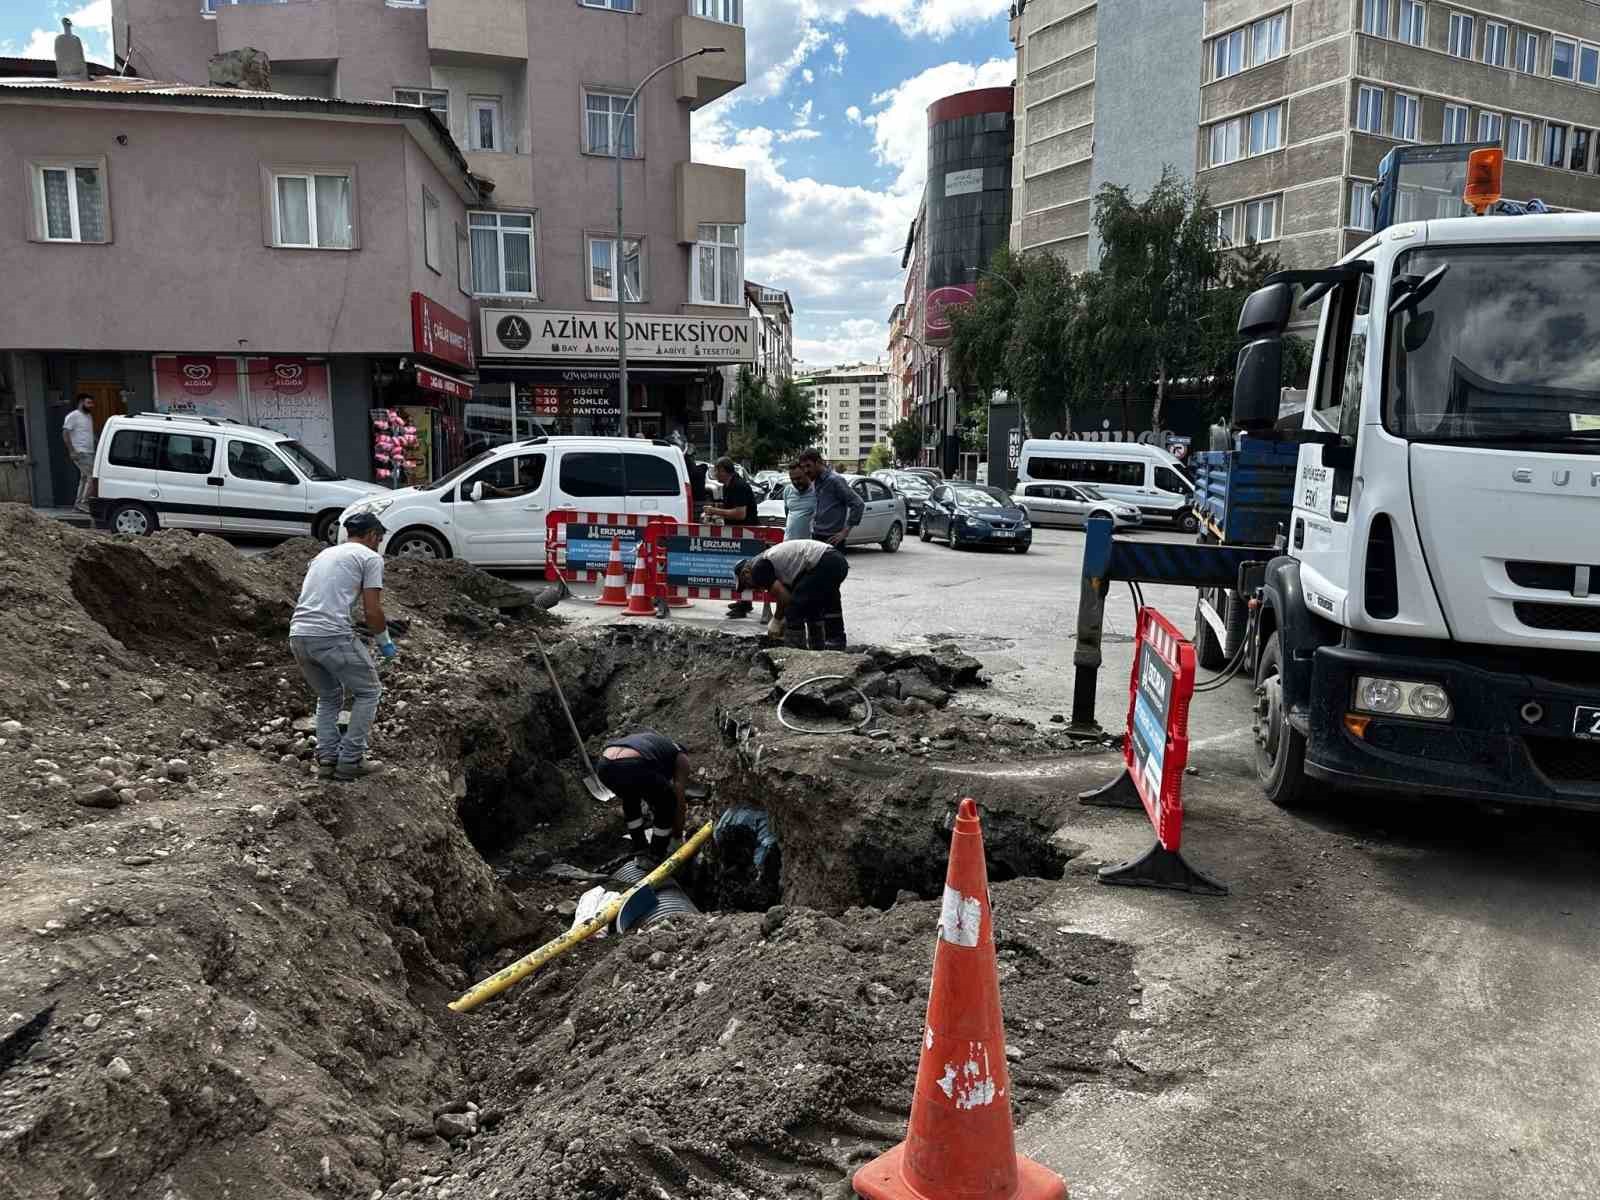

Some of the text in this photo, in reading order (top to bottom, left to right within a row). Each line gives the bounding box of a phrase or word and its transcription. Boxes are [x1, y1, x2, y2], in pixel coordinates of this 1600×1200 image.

[541, 316, 748, 343] AZİM KONFEKSİYON
[573, 407, 621, 415] PANTOLON
[600, 528, 636, 537] ERZURUM
[702, 540, 741, 550] ERZURUM
